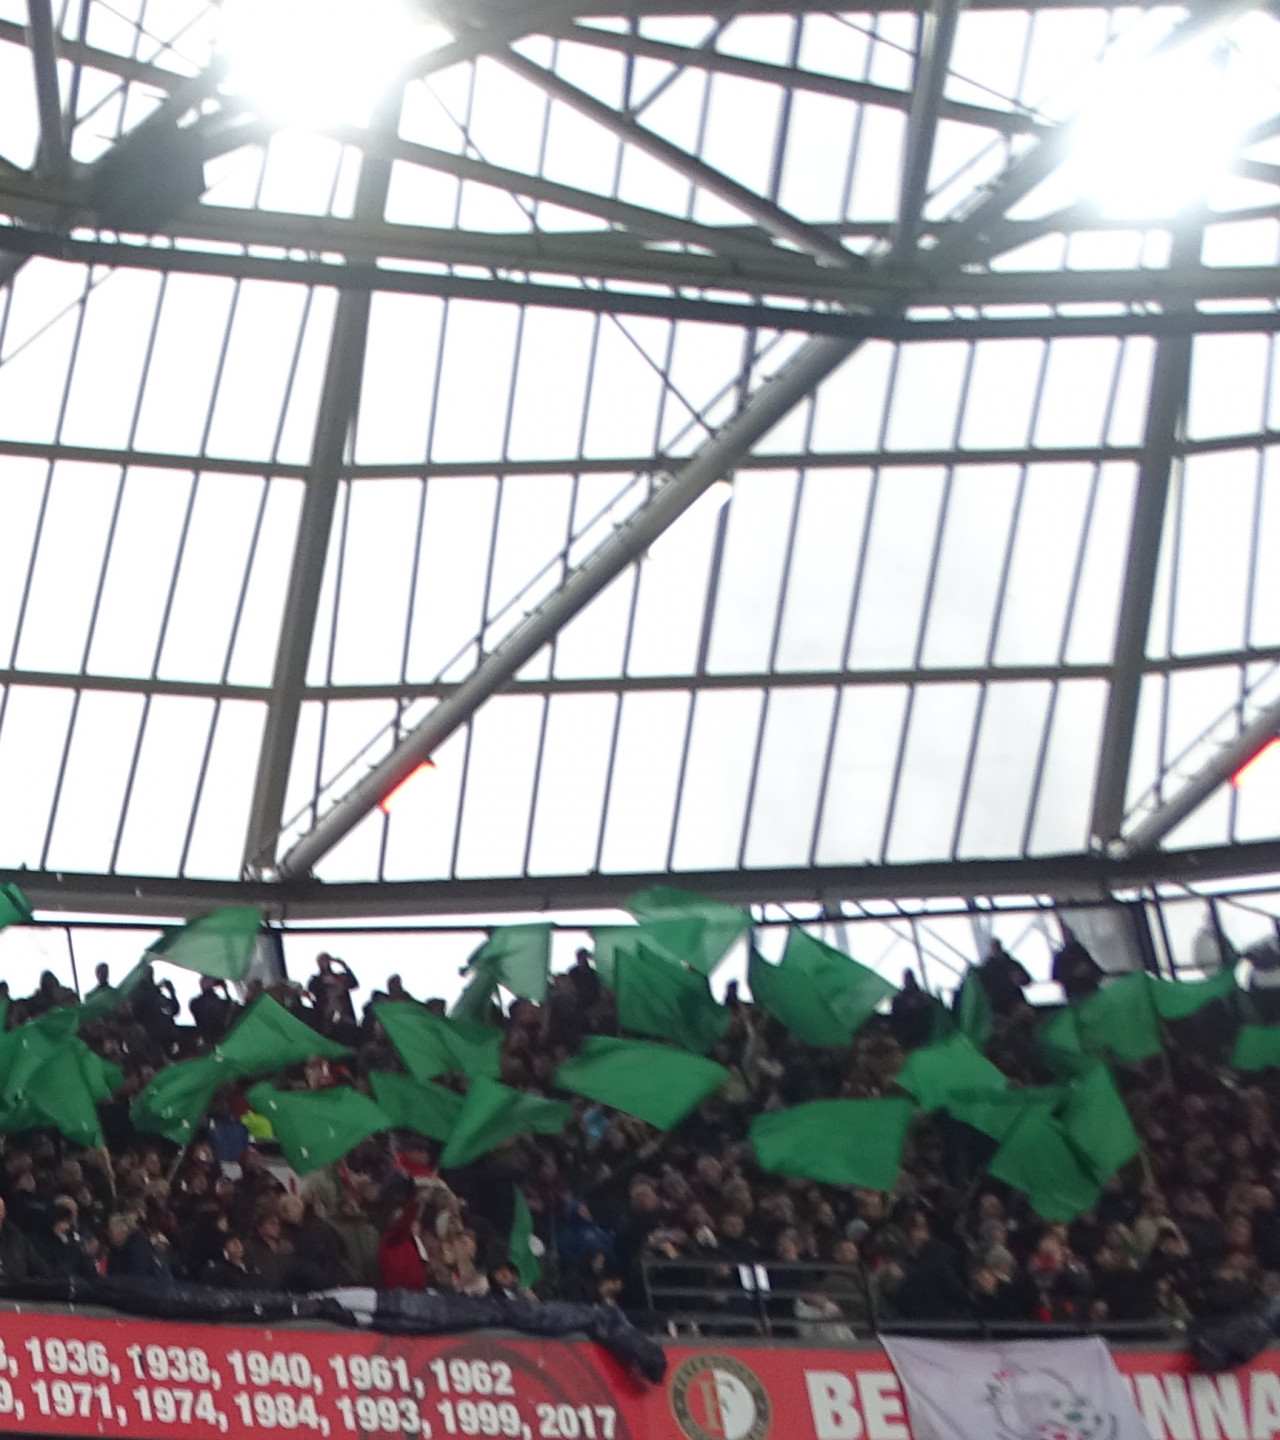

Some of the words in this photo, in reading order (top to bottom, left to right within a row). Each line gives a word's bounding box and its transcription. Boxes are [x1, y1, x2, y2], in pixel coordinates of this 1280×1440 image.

[24, 1336, 121, 1385] 1936,
[126, 1343, 222, 1391] 1938,
[226, 1349, 324, 1396] 1940,
[328, 1354, 426, 1399] 1961,
[429, 1358, 516, 1396] 1962
[30, 1378, 128, 1427] 1971,
[132, 1385, 229, 1433] 1974,
[233, 1390, 331, 1437] 1984,
[335, 1395, 433, 1440] 1993,
[536, 1402, 616, 1440] 2017
